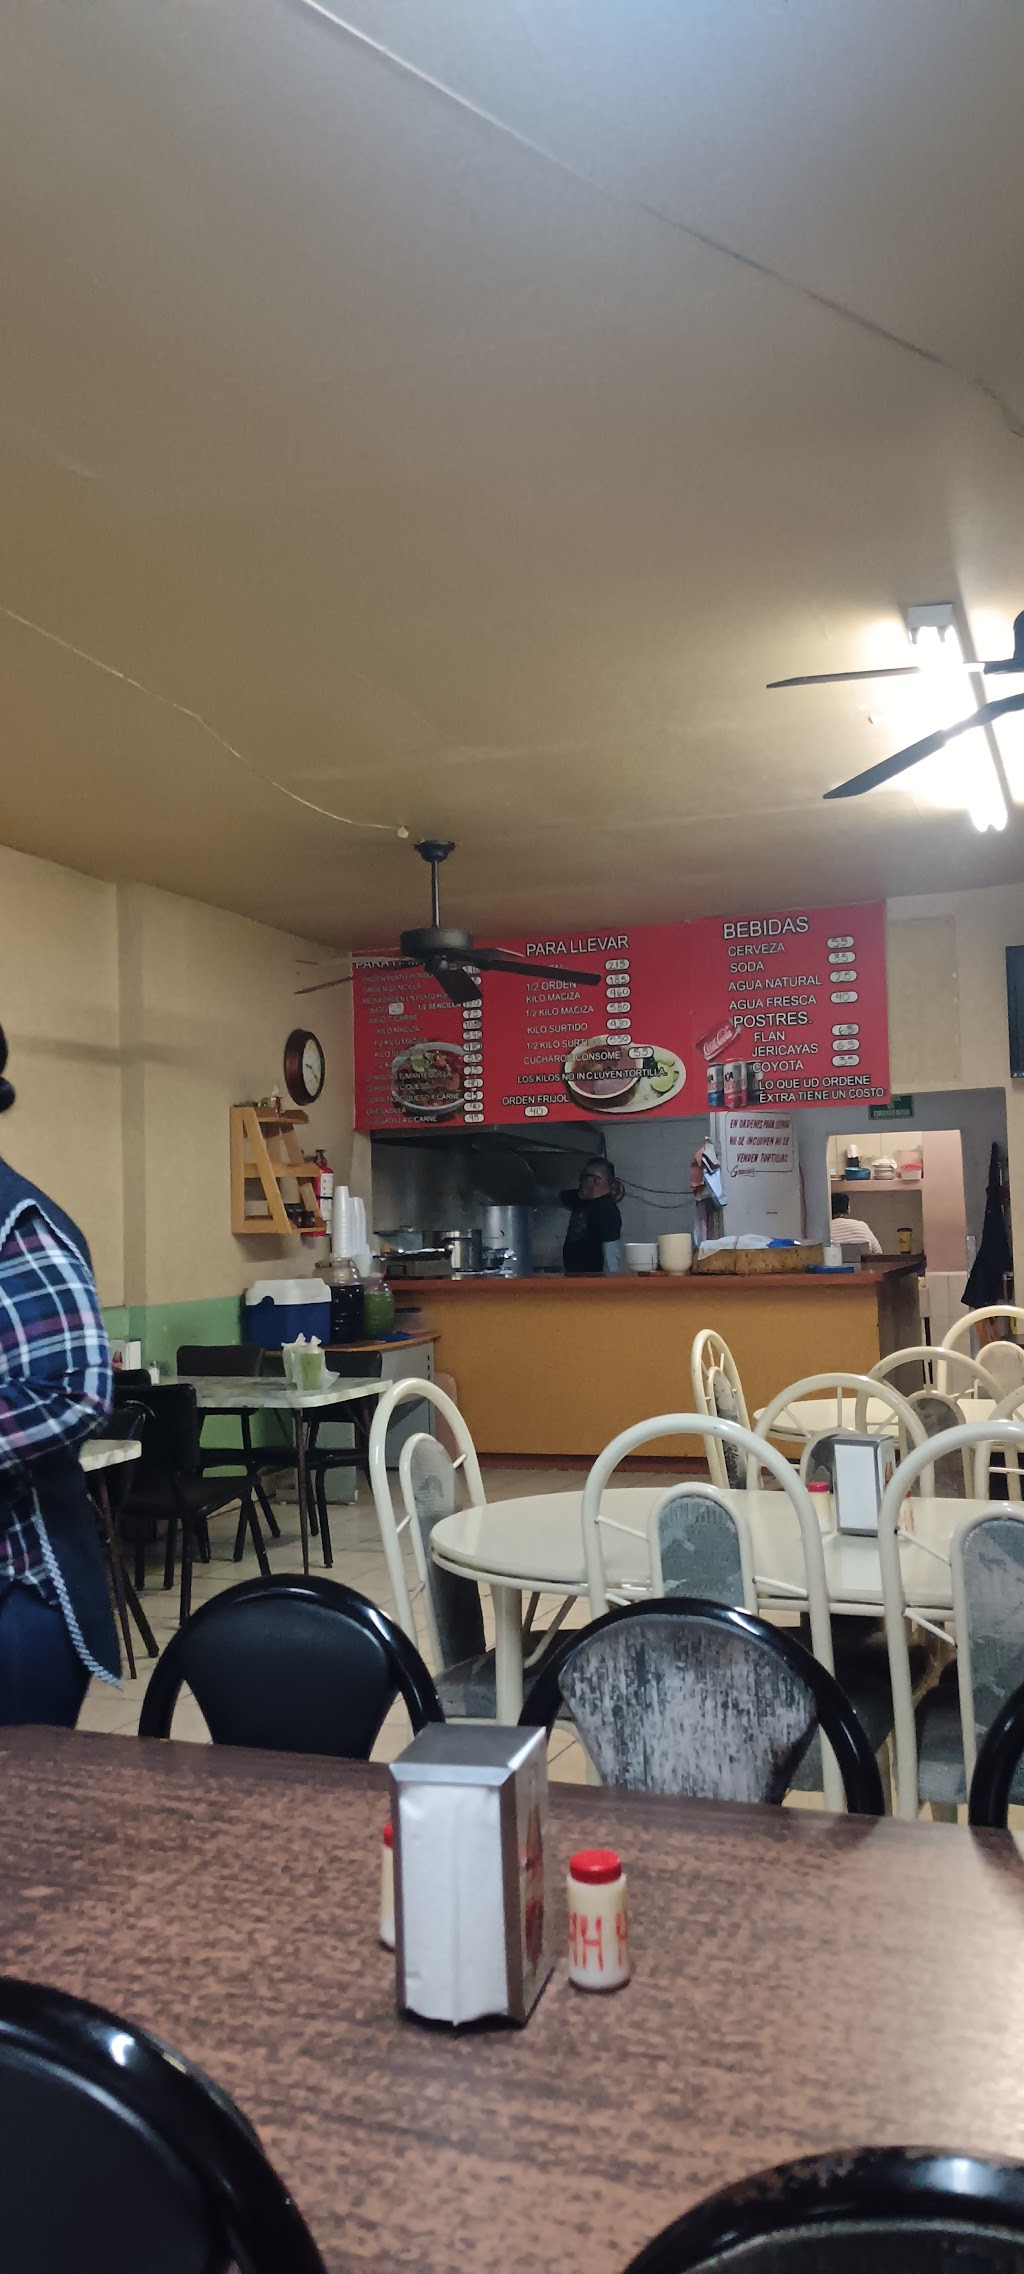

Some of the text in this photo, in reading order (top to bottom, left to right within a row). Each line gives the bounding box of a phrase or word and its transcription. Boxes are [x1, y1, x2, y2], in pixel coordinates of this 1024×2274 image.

[723, 916, 809, 940] BEBIDAS
[525, 935, 630, 957] PARA LLEVAR
[728, 942, 785, 957] CERVEZA
[833, 953, 849, 963] 35
[607, 960, 627, 970] 215
[730, 961, 765, 973] SODA
[526, 980, 577, 991] 1/2 ORDEN
[609, 975, 627, 985] 185
[728, 974, 822, 992] AGUA NATURAL
[526, 992, 581, 1003] KILO MACIZA
[609, 987, 629, 998] 960
[835, 993, 850, 1002] 40
[729, 995, 817, 1010] AGUA FRESCA
[526, 1004, 594, 1017] 1/2 KILO MACIZA
[733, 1011, 812, 1028] POSTRES.
[527, 1022, 588, 1034] KILO SURTIDO
[754, 1031, 785, 1042] FLAN
[526, 1041, 538, 1050] 1/2
[540, 1040, 559, 1049] KILO
[752, 1044, 819, 1057] JERICAYAS
[837, 1041, 856, 1050] 65
[523, 1051, 621, 1065] CUCHARON CONSOME
[633, 1048, 649, 1057] 55
[838, 1055, 854, 1066] 35
[752, 1060, 804, 1073] COYOTA
[517, 1075, 535, 1084] LOS
[535, 1074, 560, 1083] KILOS
[561, 1073, 575, 1081] NO
[759, 1075, 870, 1090] LO QUE UD ORDENE
[437, 1092, 460, 1100] CARNE
[502, 1095, 535, 1105] ORDEN
[759, 1087, 884, 1103] EXTRA TIENE UN COSTO
[529, 1107, 544, 1116] 40
[407, 1115, 438, 1123] C/CARNE
[730, 1119, 738, 1128] EN
[737, 1153, 788, 1163] VENDEN TORTILLAS
